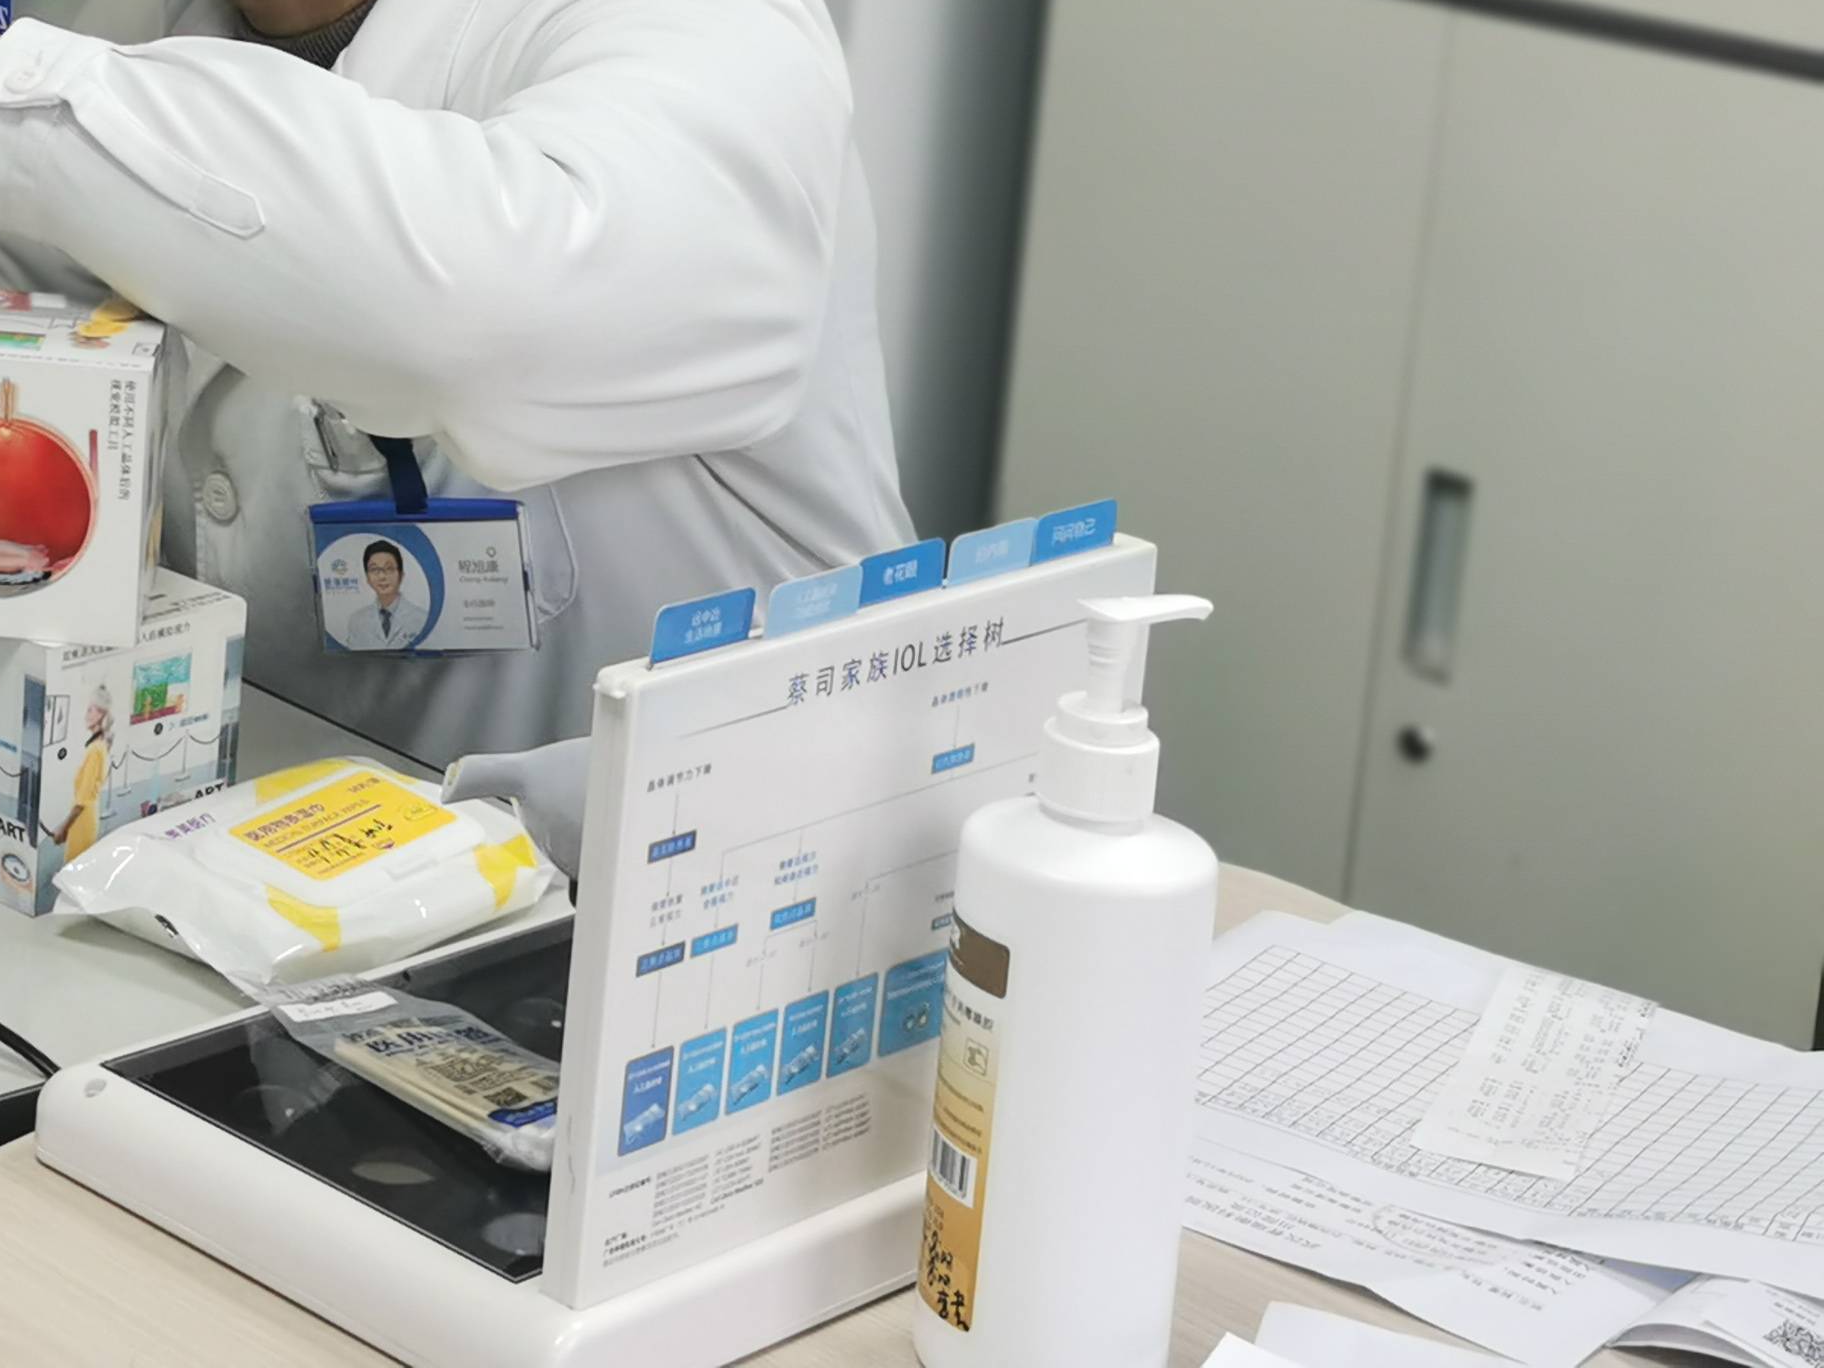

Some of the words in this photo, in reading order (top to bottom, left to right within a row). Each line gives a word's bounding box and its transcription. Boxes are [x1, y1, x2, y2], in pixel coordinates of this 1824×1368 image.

[786, 616, 1005, 706] 蔡司家族IOL选择树
